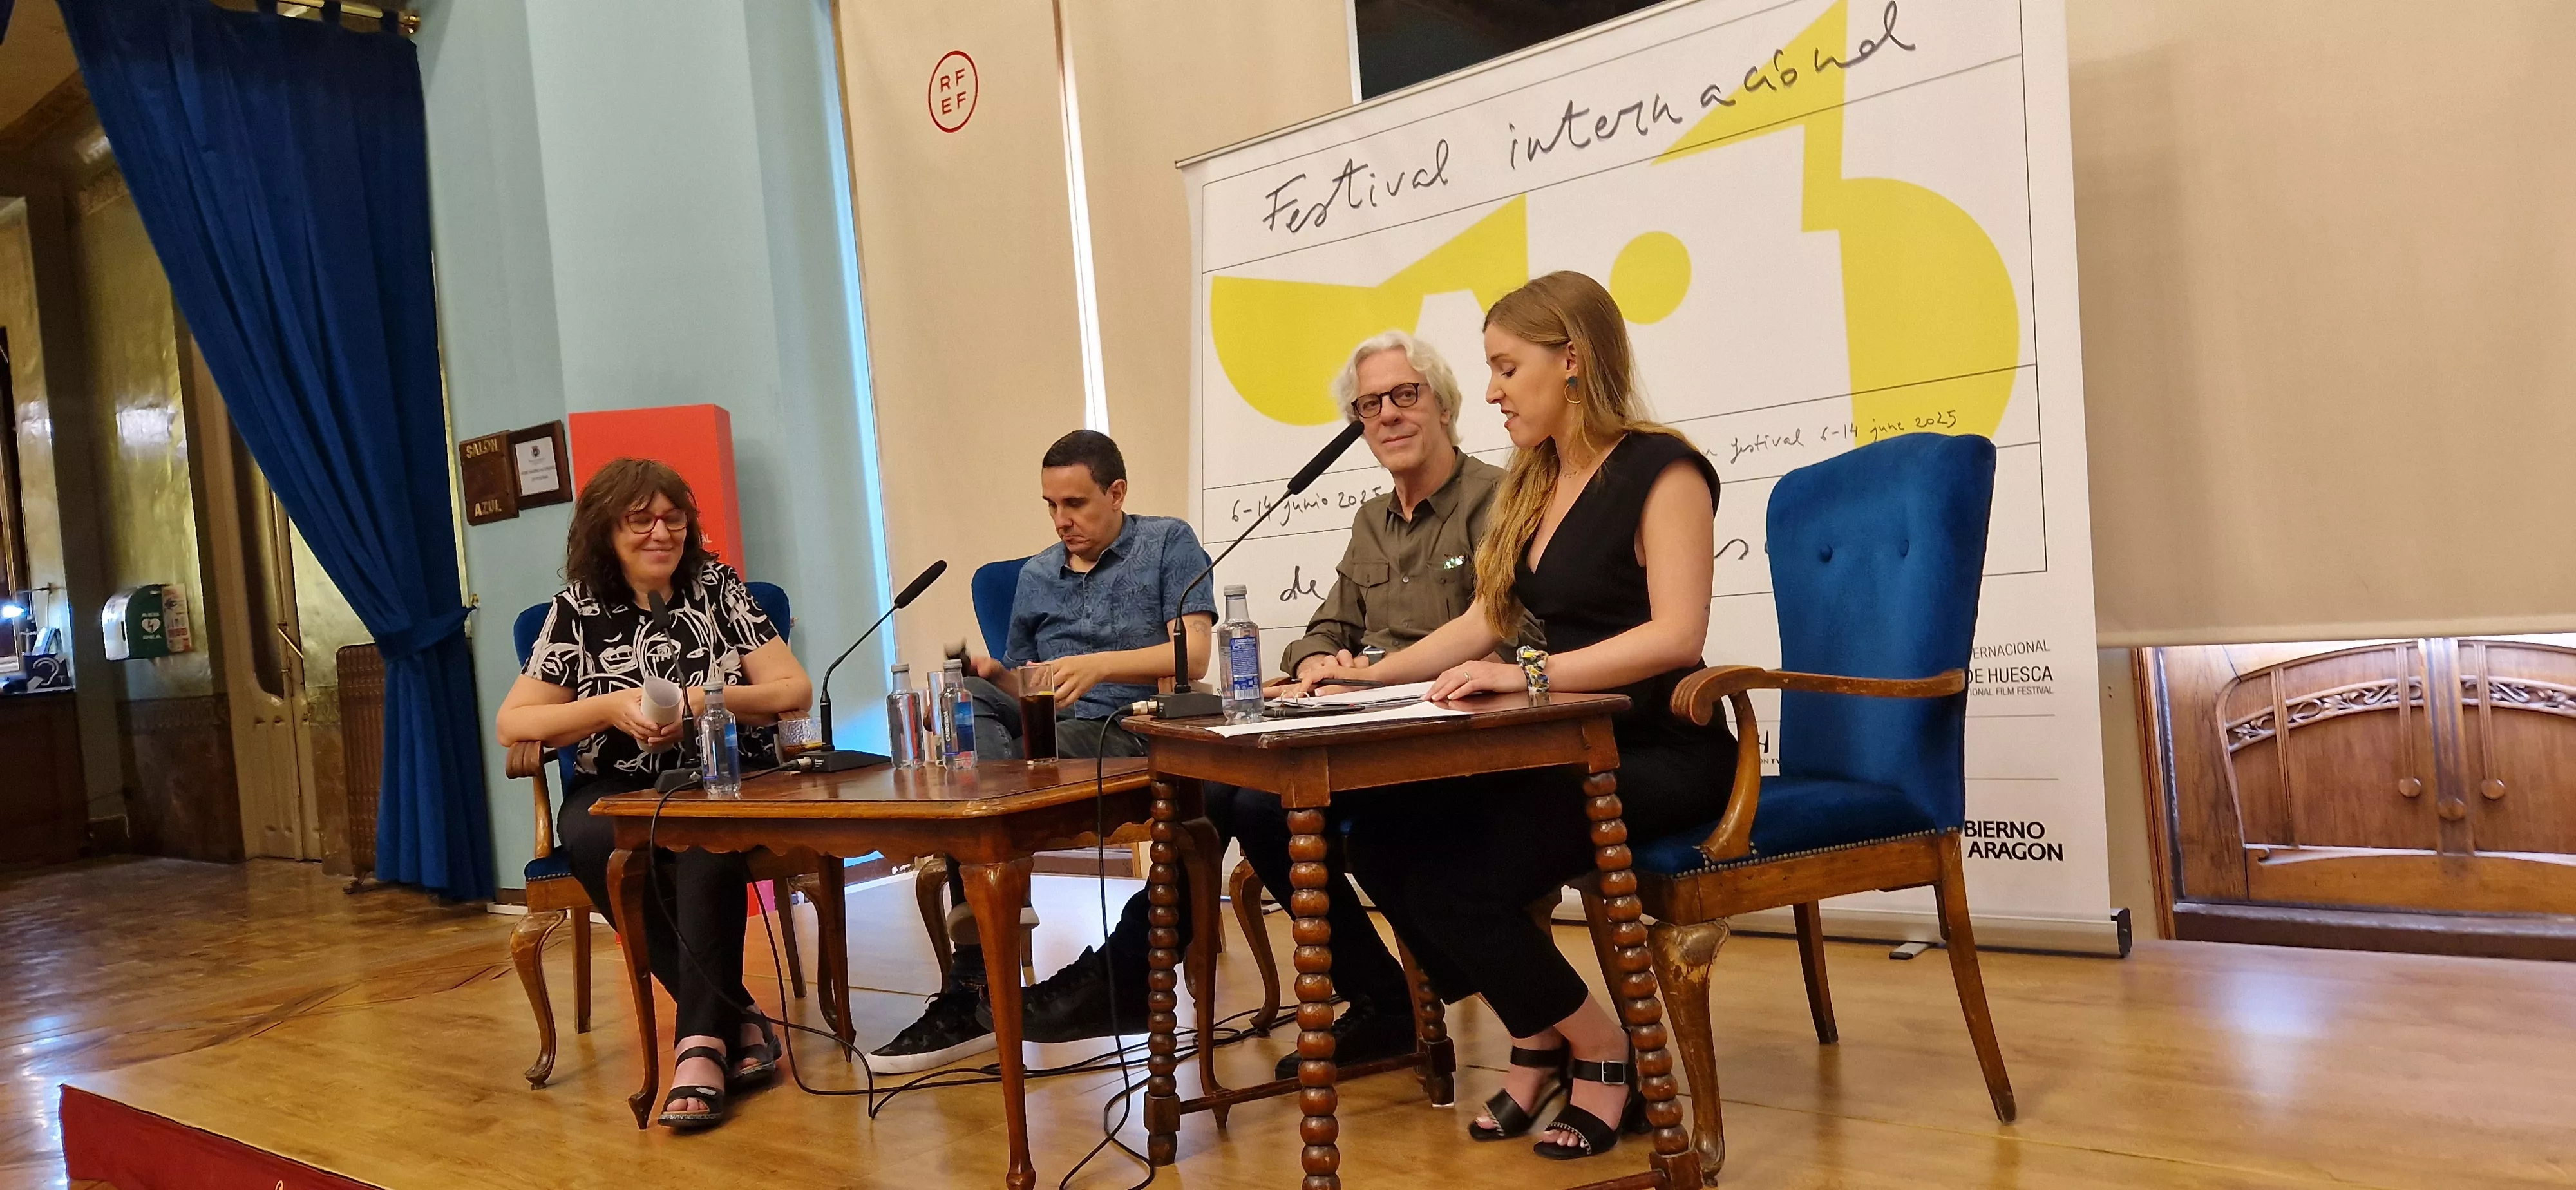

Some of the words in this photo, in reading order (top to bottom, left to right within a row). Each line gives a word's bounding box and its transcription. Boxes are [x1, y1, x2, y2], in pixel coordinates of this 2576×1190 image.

[1263, 138, 1449, 233] Festival
[1730, 428, 1804, 464] festival
[1820, 422, 1859, 442] 6-14
[1870, 418, 1905, 443] june
[1915, 409, 1957, 428] 2025
[475, 499, 502, 517] AZUL
[1280, 493, 1328, 527] junio
[1280, 565, 1327, 601] de
[1972, 639, 2051, 659] ERNACIONAL
[1987, 665, 2054, 684] HUESCA
[1970, 687, 1993, 696] IONAL
[1996, 686, 2014, 696] FILM
[2016, 685, 2054, 695] FESTIVAL
[1964, 820, 2045, 840] BIERNO
[1967, 840, 2063, 862] ARAGON
